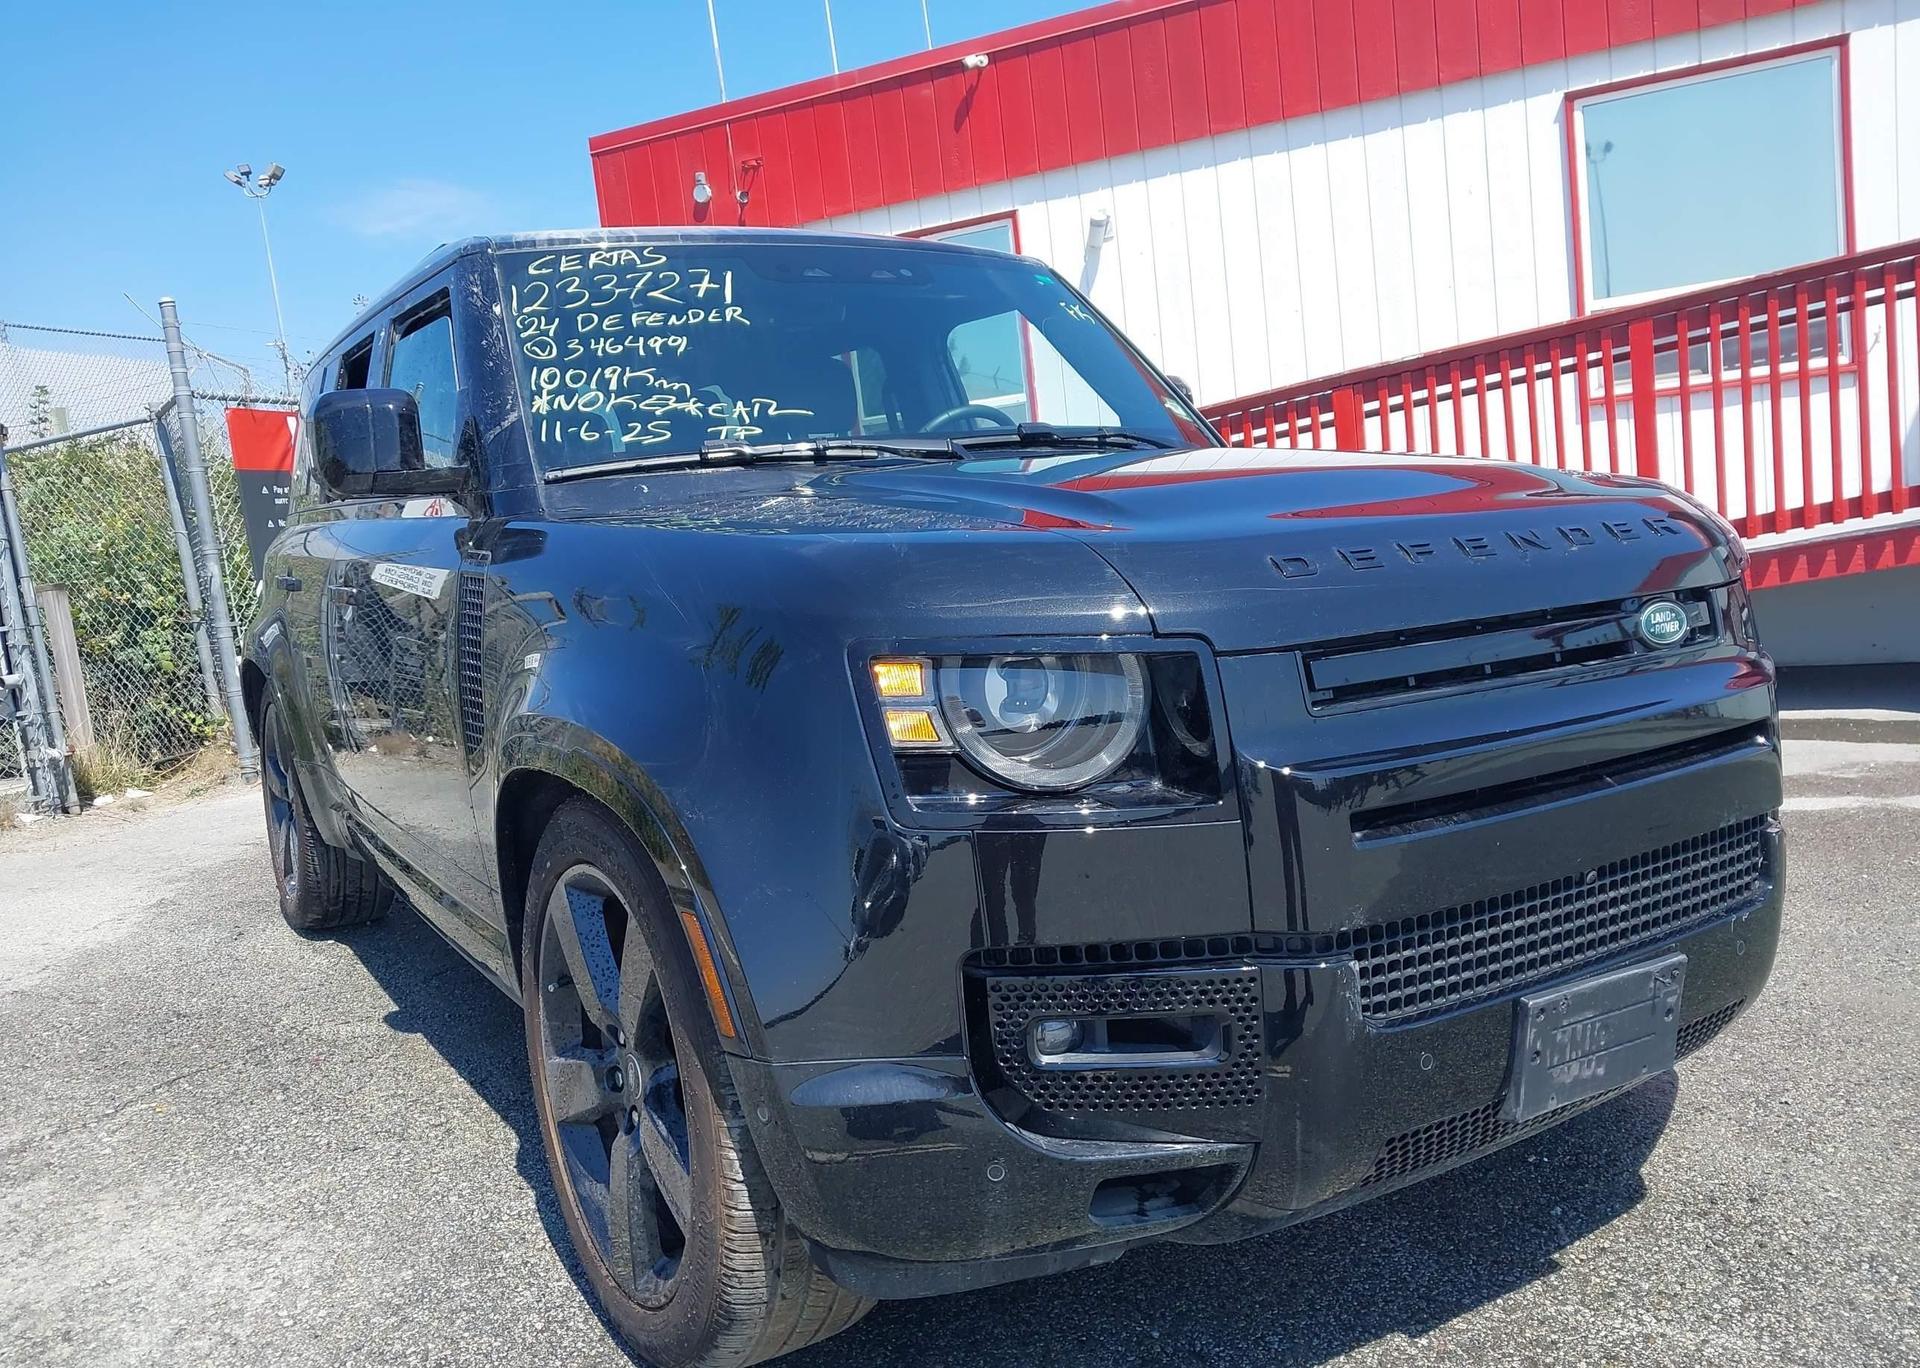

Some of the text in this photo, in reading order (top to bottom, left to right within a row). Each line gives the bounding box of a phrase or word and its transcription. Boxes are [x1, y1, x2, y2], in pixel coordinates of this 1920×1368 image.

[528, 247, 667, 275] CERTAS
[577, 306, 750, 333] DEFENDER
[1269, 516, 1682, 579] DEFENDER
[1650, 610, 1671, 624] LAND
[1654, 620, 1680, 635] ROVER
